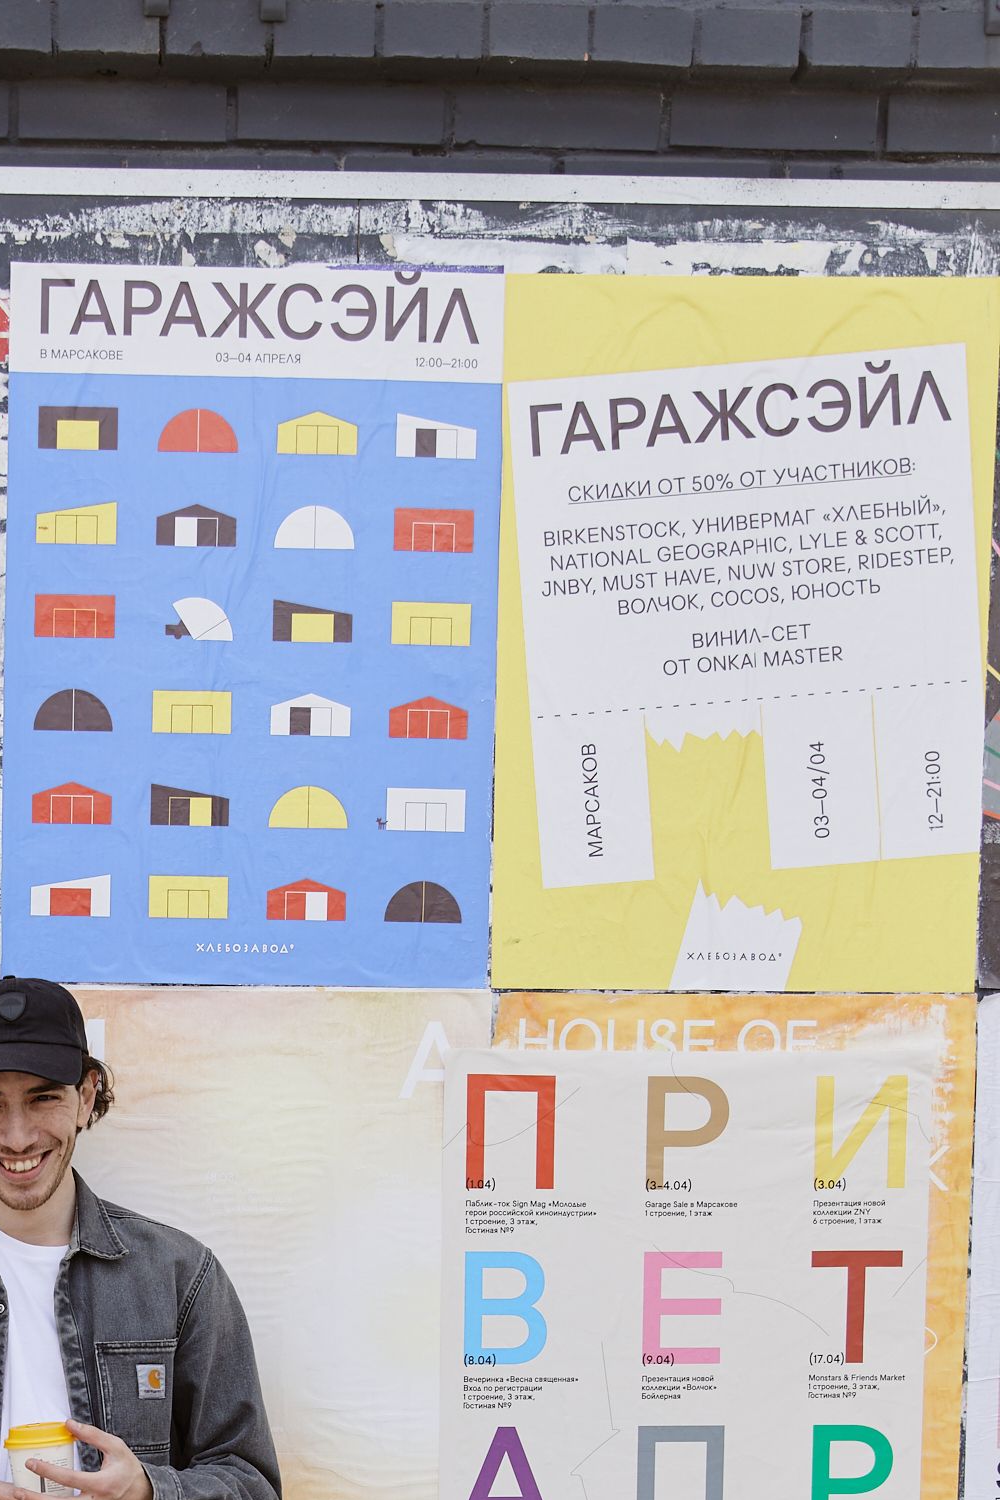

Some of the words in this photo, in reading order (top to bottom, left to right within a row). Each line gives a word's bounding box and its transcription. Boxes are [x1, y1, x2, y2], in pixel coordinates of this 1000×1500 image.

[40, 272, 479, 346] ГАРАЖСЭЙЛ
[40, 349, 47, 360] В
[50, 349, 123, 361] МАРСАКОВЕ
[254, 353, 301, 365] АПРЕЛЯ
[530, 359, 952, 457] ГАРАЖСЭЙЛ
[568, 480, 652, 503] СКИДКИ
[658, 477, 686, 495] ОТ
[691, 473, 734, 493] 50%
[739, 470, 767, 489] ОТ
[773, 458, 917, 486] УЧАСТНИКОВ:
[543, 520, 686, 547] BIRKENSTOCK,
[692, 509, 816, 535] УНИВЕРМАГ
[822, 494, 946, 523] «ХЛЕБНЫЙ»,
[550, 548, 651, 572] NATIONAL
[657, 536, 793, 563] GEOGRAPHIC,
[799, 531, 847, 551] LYLE
[855, 529, 869, 546] &
[874, 523, 943, 545] SCOTT,
[541, 578, 597, 599] JNBY,
[602, 571, 658, 592] MUST
[664, 567, 721, 587] HAVE,
[727, 562, 776, 581] NUW
[781, 556, 852, 577] STORE,
[858, 547, 955, 571] RIDESTEP,
[617, 593, 705, 616] ВОЛЧОК,
[710, 587, 785, 609] COCOS,
[791, 579, 881, 601] ЮНОСТЬ
[691, 624, 811, 649] ВИНИЛ-СЕТ
[662, 658, 690, 676] ОТ
[763, 645, 843, 667] MASTER
[581, 743, 604, 858] МАРСАКОВ
[466, 1074, 556, 1189] П
[646, 1075, 730, 1190] Р
[812, 1075, 908, 1189] И
[465, 1178, 496, 1191] (1.04)
[645, 1179, 692, 1191] (3-4.04)
[813, 1178, 847, 1191] (3.04)
[465, 1200, 510, 1208] Паблик-ток
[512, 1200, 528, 1209] Sign
[530, 1201, 546, 1209] Mag
[645, 1201, 671, 1209] Garage
[673, 1200, 689, 1208] Sale
[697, 1201, 738, 1209] Марсакове
[813, 1200, 862, 1208] Презентация
[465, 1210, 487, 1218] герои
[489, 1209, 534, 1218] российской
[470, 1219, 508, 1227] строение,
[517, 1219, 538, 1227] этаж,
[819, 1218, 857, 1226] строение,
[463, 1252, 547, 1364] В
[642, 1252, 722, 1364] Е
[811, 1250, 903, 1363] Т
[463, 1353, 497, 1366] (8.04)
[642, 1353, 675, 1366] (9.04)
[809, 1352, 845, 1366] (17.04)
[463, 1376, 504, 1385] Вечеринка
[534, 1376, 579, 1384] священная»
[642, 1375, 690, 1384] Презентация
[691, 1375, 715, 1383] новой
[808, 1374, 842, 1382] Monstars
[843, 1374, 849, 1382] &
[851, 1374, 878, 1382] Friends
[880, 1374, 906, 1382] Market
[642, 1384, 681, 1392] коллекции
[682, 1384, 718, 1392] «Волчок»
[812, 1384, 850, 1392] строение,
[467, 1394, 506, 1402] строение,
[514, 1394, 536, 1402] этаж,
[642, 1392, 681, 1400] Бойлерная
